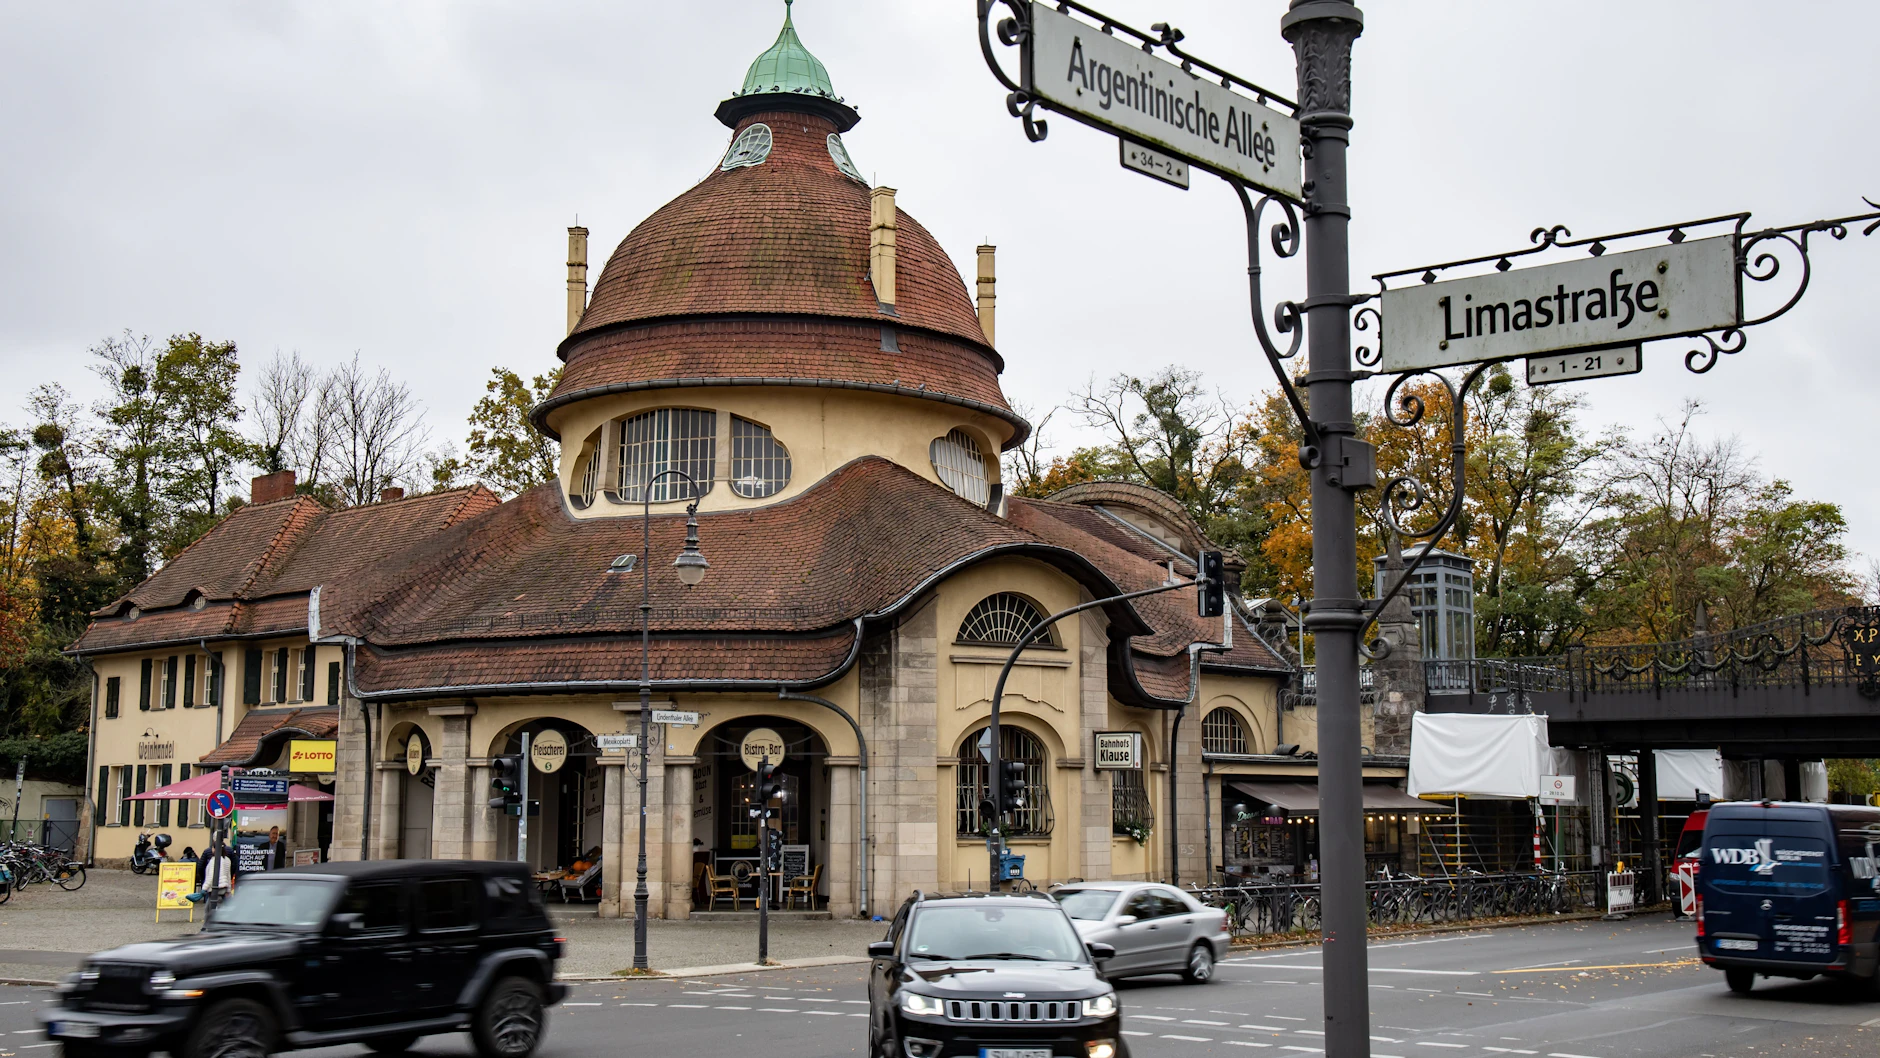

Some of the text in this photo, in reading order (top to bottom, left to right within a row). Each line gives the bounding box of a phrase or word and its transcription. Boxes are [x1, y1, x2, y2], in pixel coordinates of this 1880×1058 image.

[1067, 36, 1275, 167] Argentinische Allee
[1444, 269, 1659, 341] Limastraße
[683, 714, 694, 722] Allee
[1100, 739, 1129, 748] Bahnhofs
[138, 740, 175, 760] Weinhandel
[305, 752, 333, 760] LOTTO
[533, 744, 565, 756] Fleischerei
[1100, 749, 1129, 762] Klause
[693, 806, 712, 818] emüse
[1711, 848, 1760, 864] WDB
